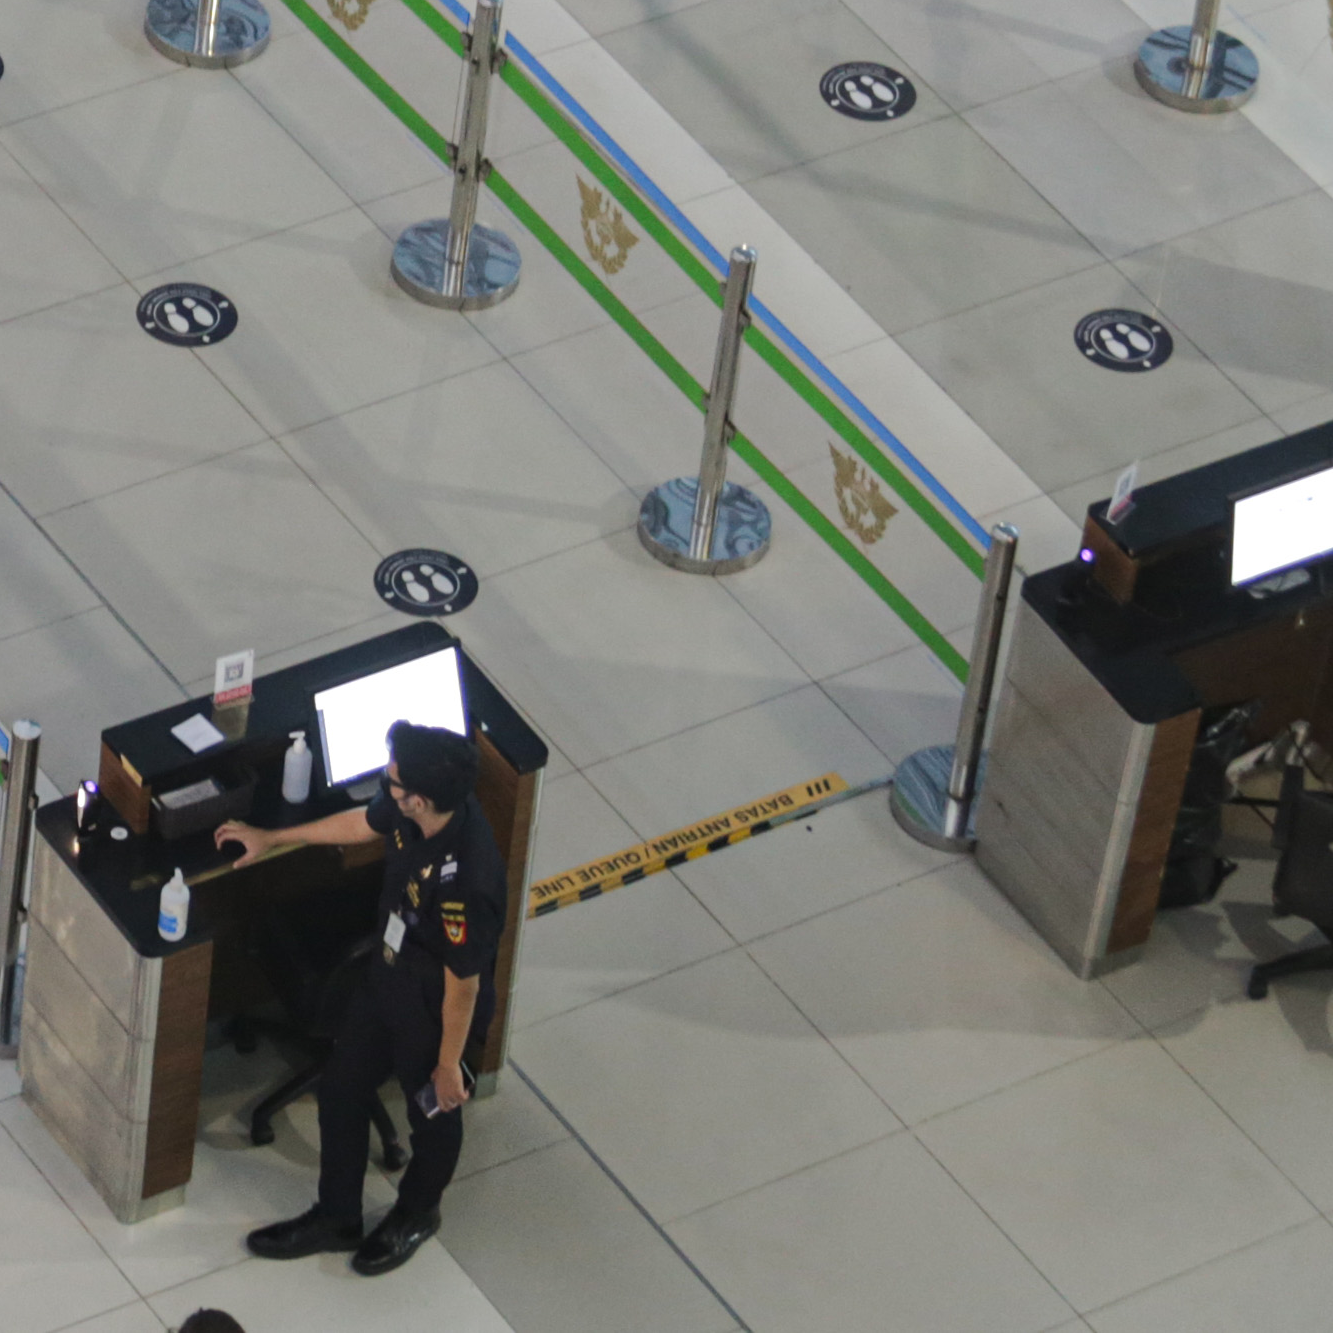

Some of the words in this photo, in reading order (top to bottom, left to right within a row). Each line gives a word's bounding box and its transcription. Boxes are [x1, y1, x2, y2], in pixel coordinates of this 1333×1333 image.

[734, 793, 794, 824] BATAS
[644, 845, 651, 859] /
[653, 817, 732, 857] ANTRIAN
[575, 851, 642, 883] QUEUE
[530, 876, 575, 899] LINE
